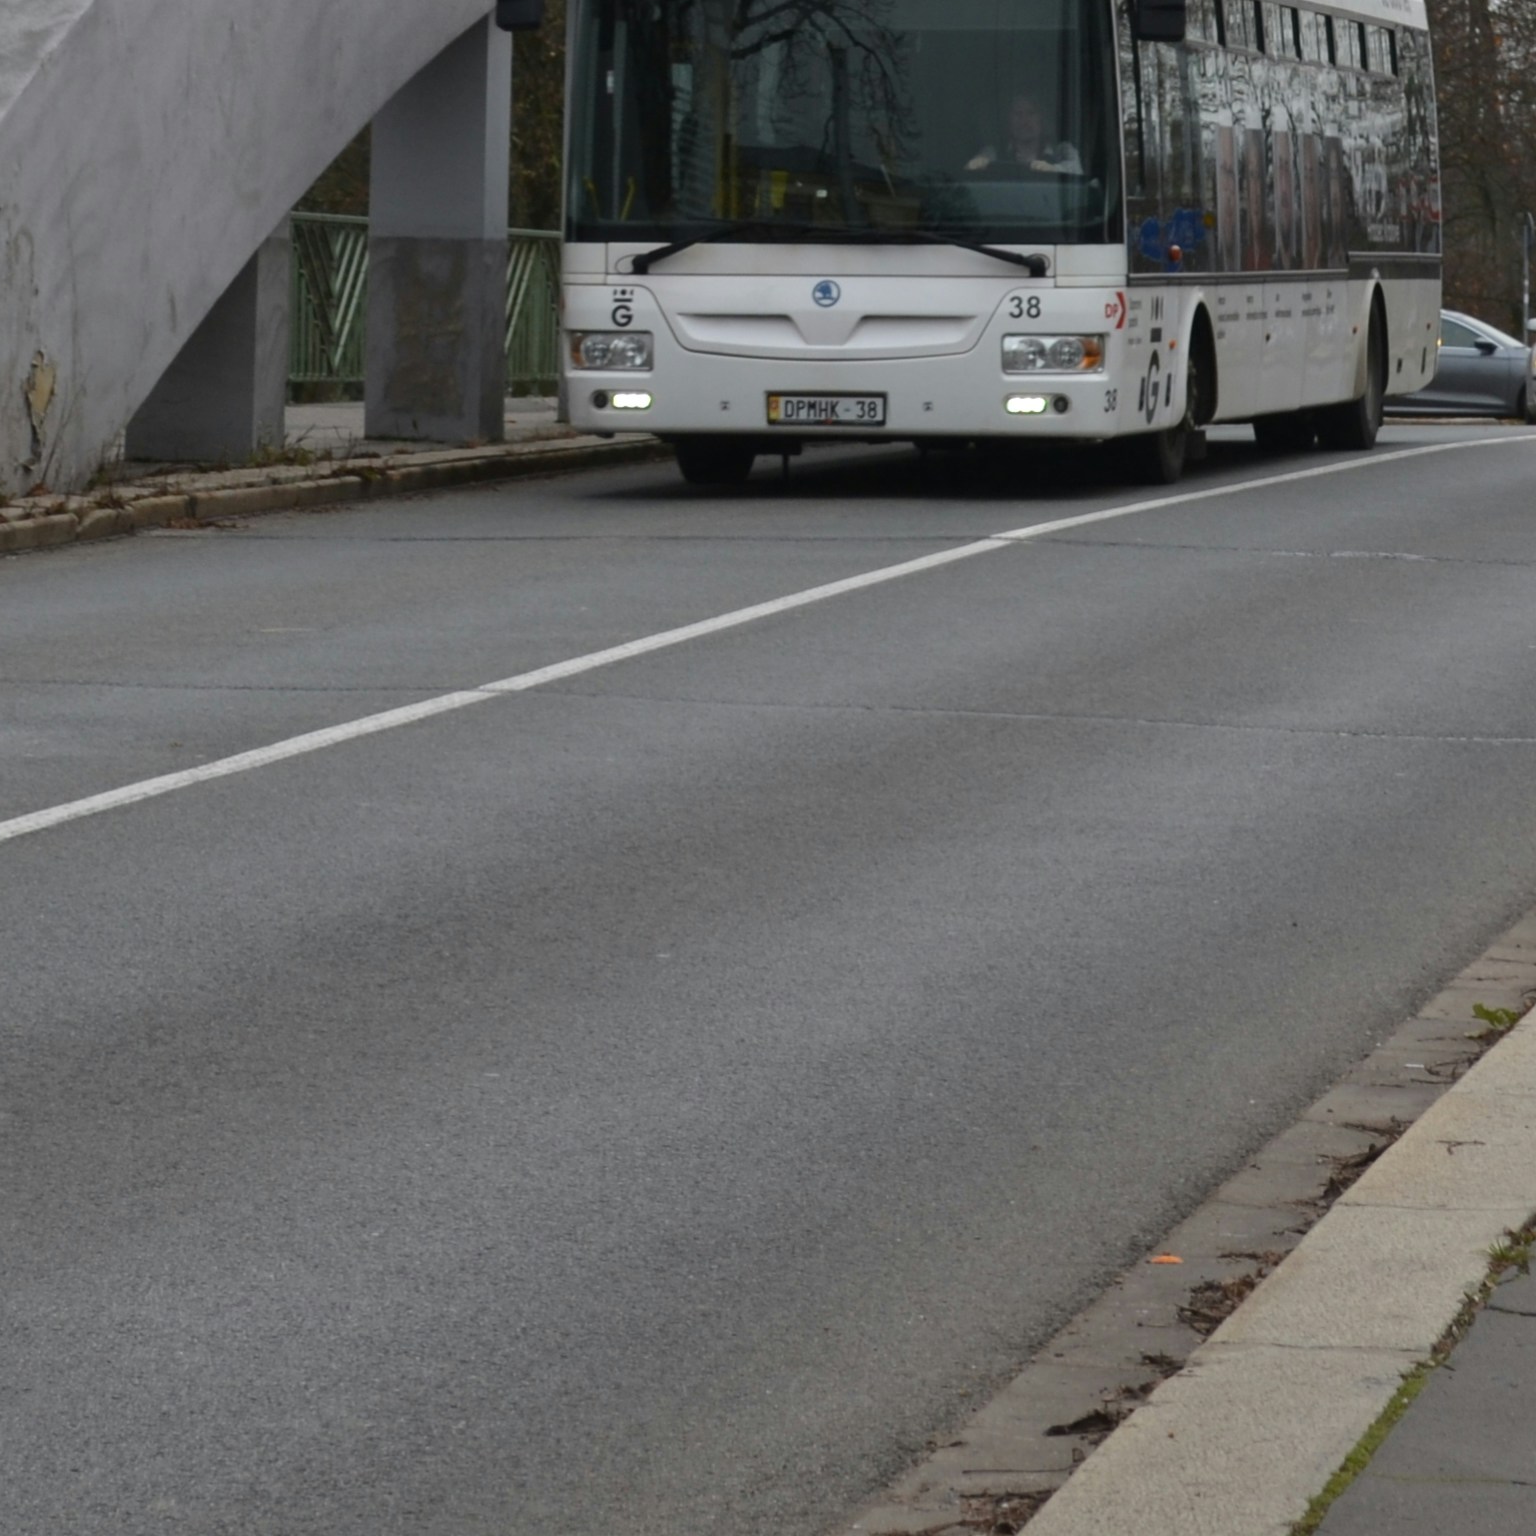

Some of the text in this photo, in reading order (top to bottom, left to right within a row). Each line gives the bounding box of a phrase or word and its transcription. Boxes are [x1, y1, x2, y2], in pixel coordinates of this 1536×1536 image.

[611, 305, 633, 327] G
[1009, 296, 1041, 318] 38
[784, 400, 840, 418] DPMHK
[855, 401, 878, 419] 38
[1104, 389, 1117, 412] 38
